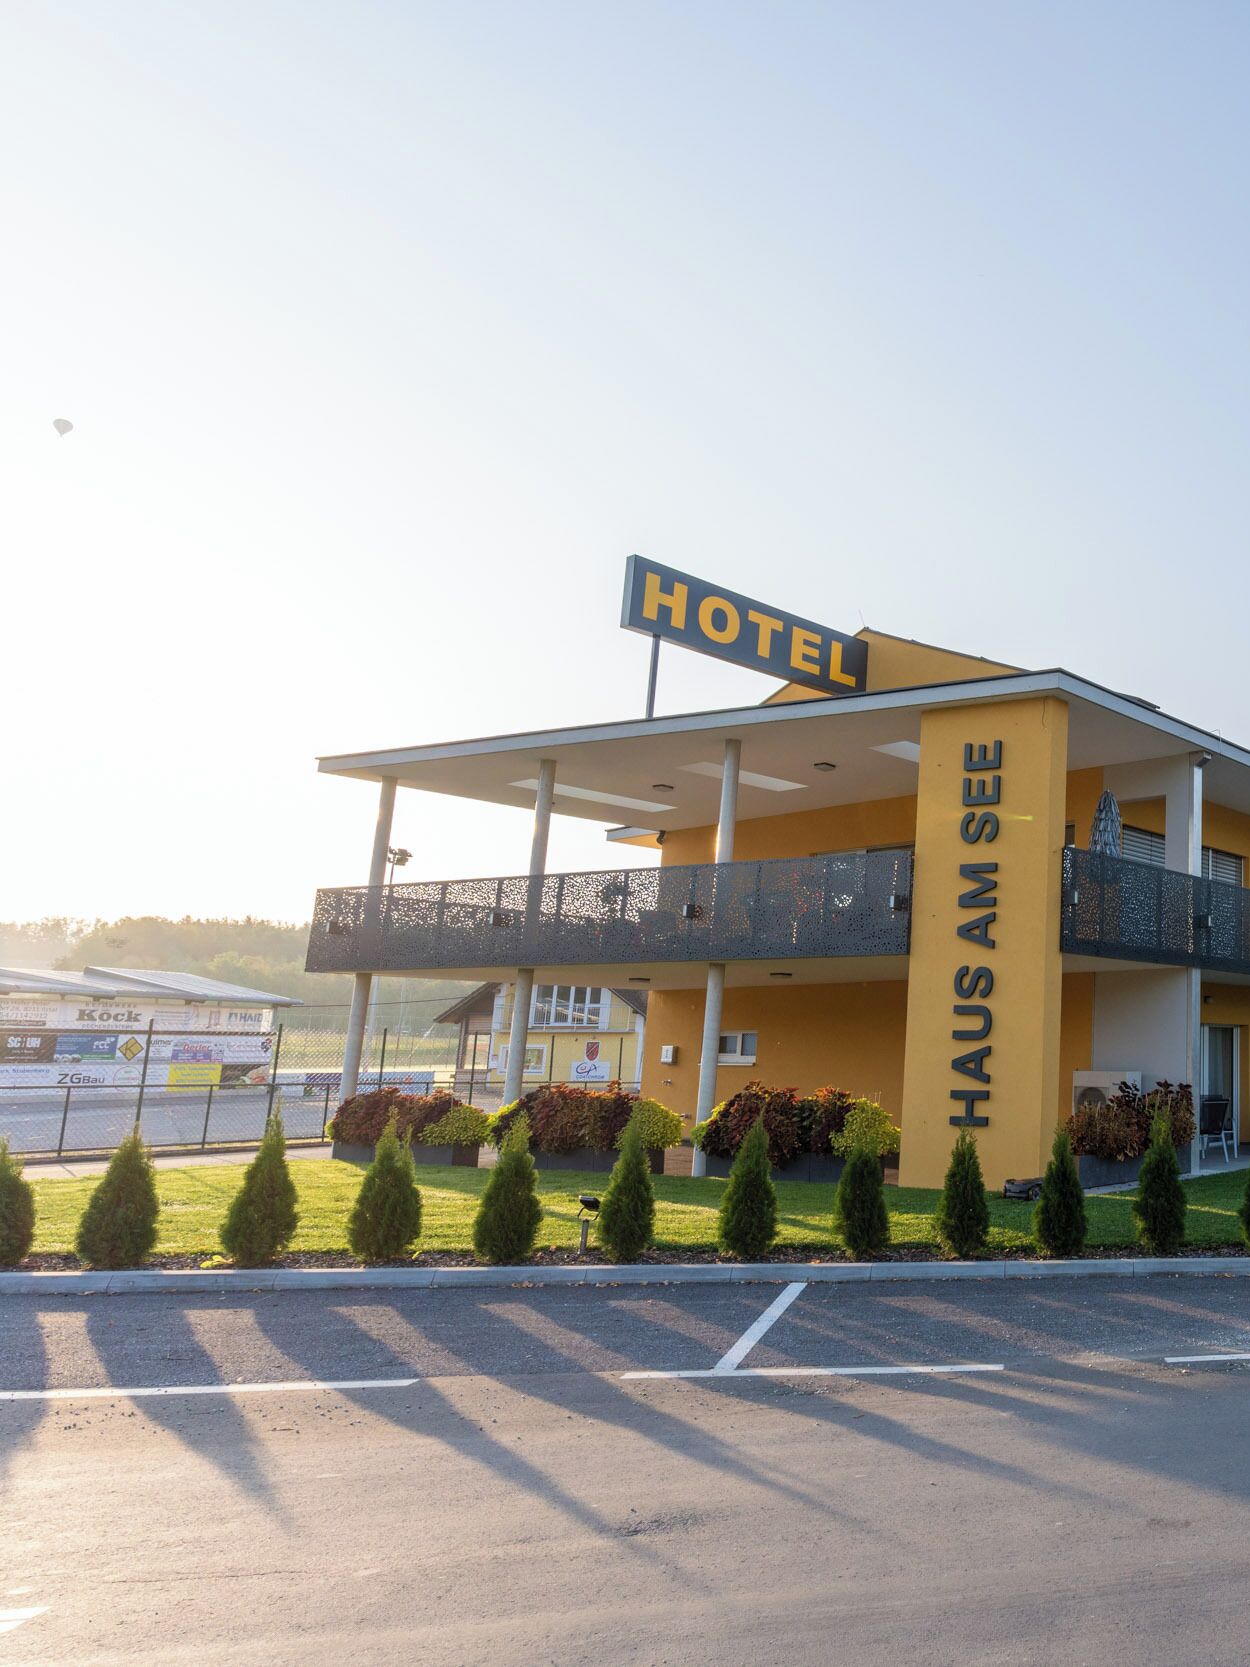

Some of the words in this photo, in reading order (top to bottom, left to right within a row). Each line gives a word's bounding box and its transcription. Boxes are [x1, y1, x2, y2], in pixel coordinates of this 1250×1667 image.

[642, 571, 856, 688] HOTEL
[960, 739, 1003, 845] SEE
[957, 862, 998, 949] AM
[949, 965, 994, 1128] HAUS
